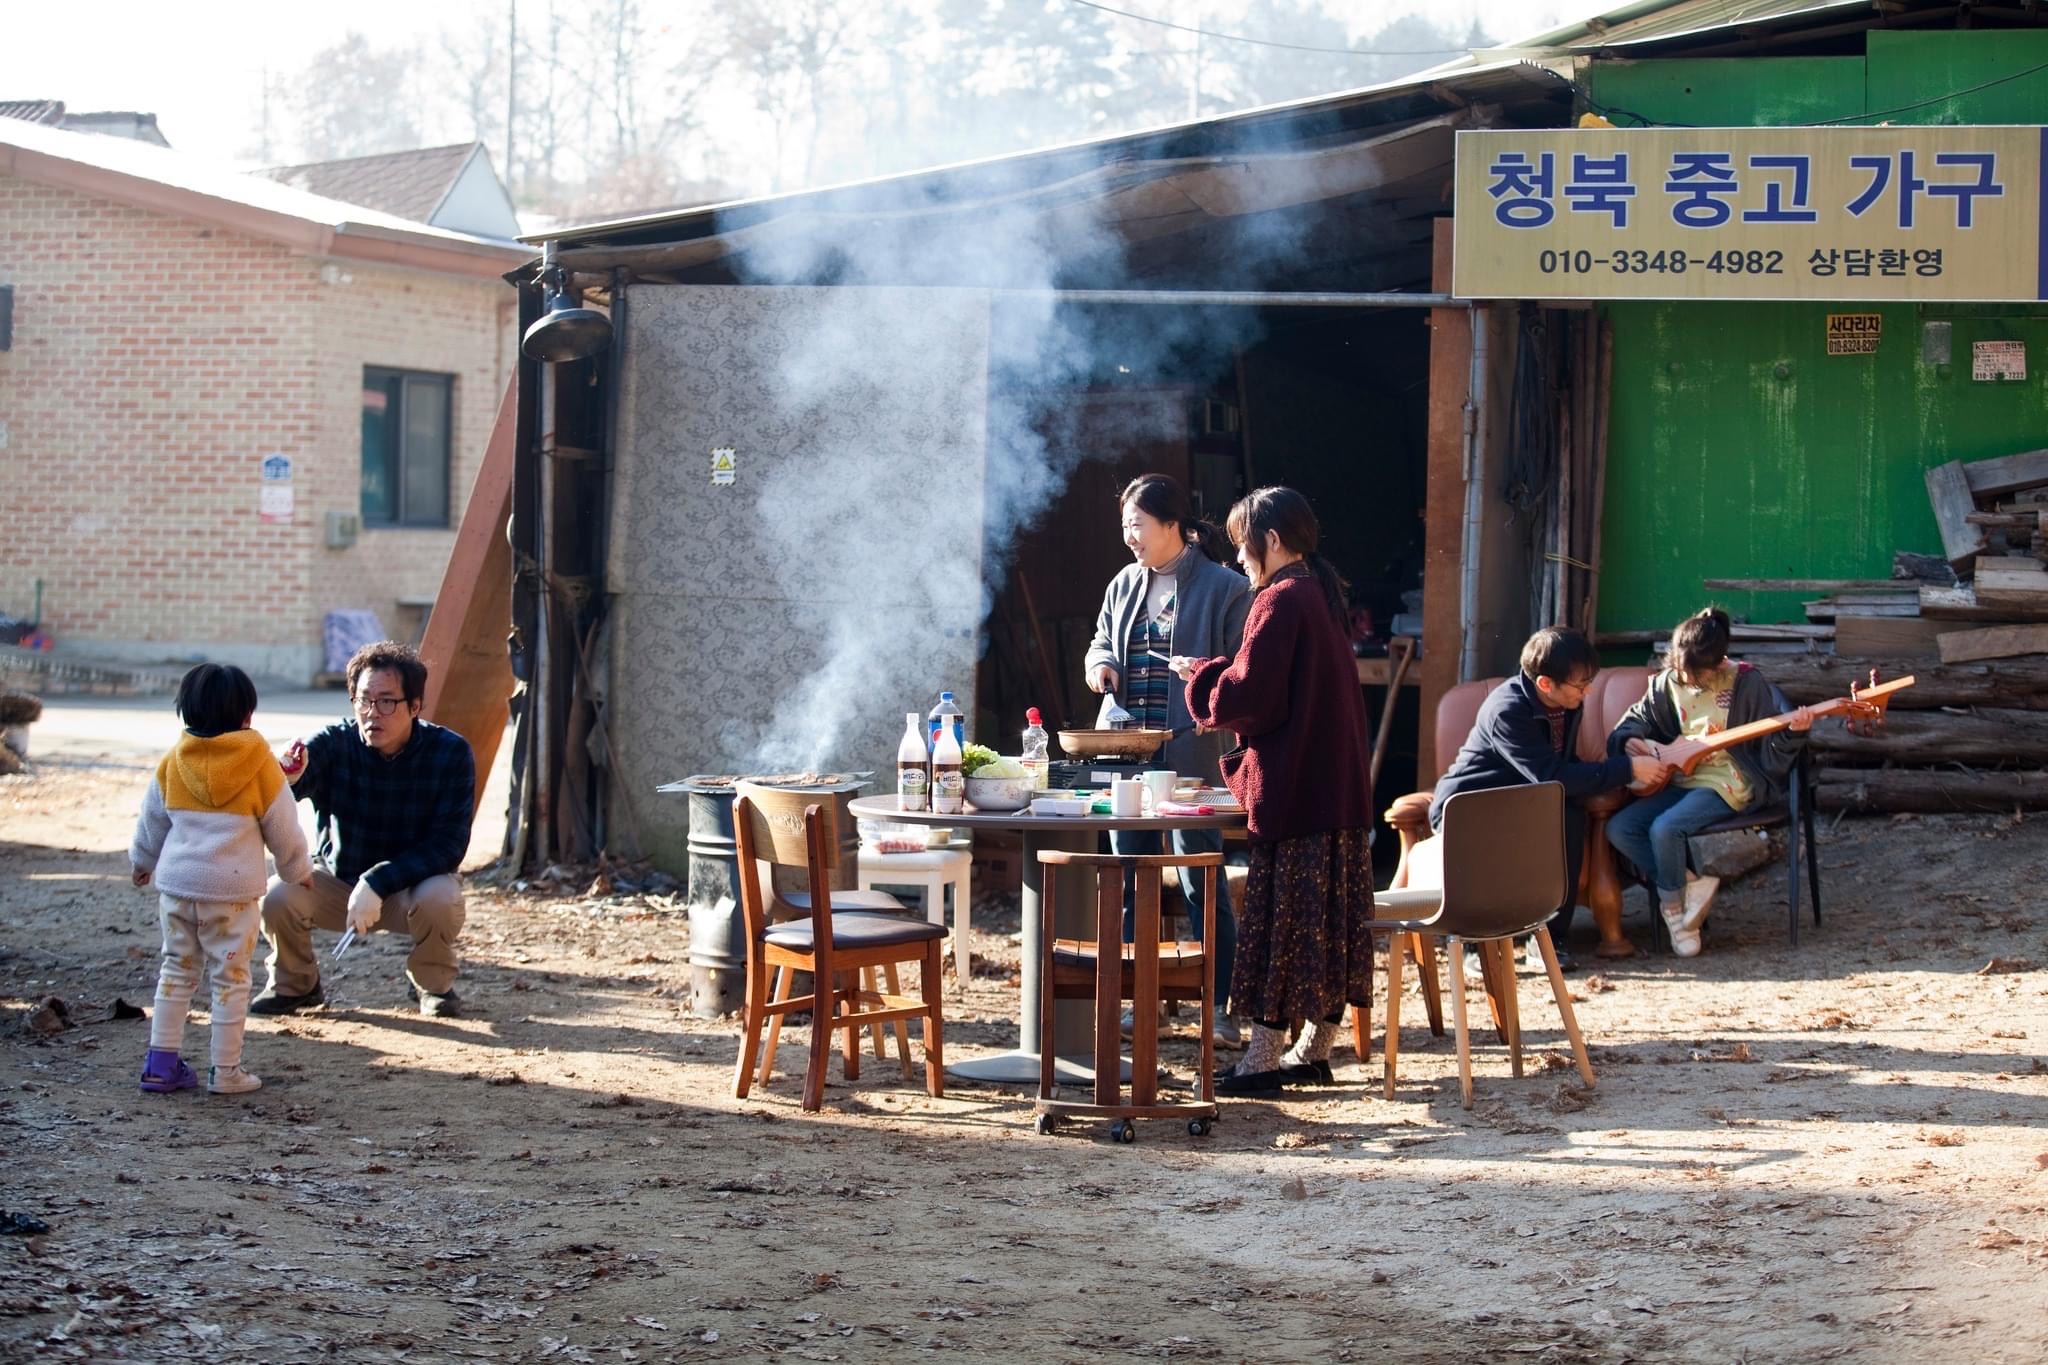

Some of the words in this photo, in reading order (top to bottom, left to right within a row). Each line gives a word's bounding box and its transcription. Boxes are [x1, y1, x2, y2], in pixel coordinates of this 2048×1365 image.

[1488, 151, 1637, 230] 청북
[1664, 150, 1819, 230] 중고
[1846, 149, 2005, 230] 가구
[1539, 249, 1784, 275] 010-3348-4982
[1808, 248, 1944, 277] 상담환영
[1829, 316, 1880, 332] 사다리차
